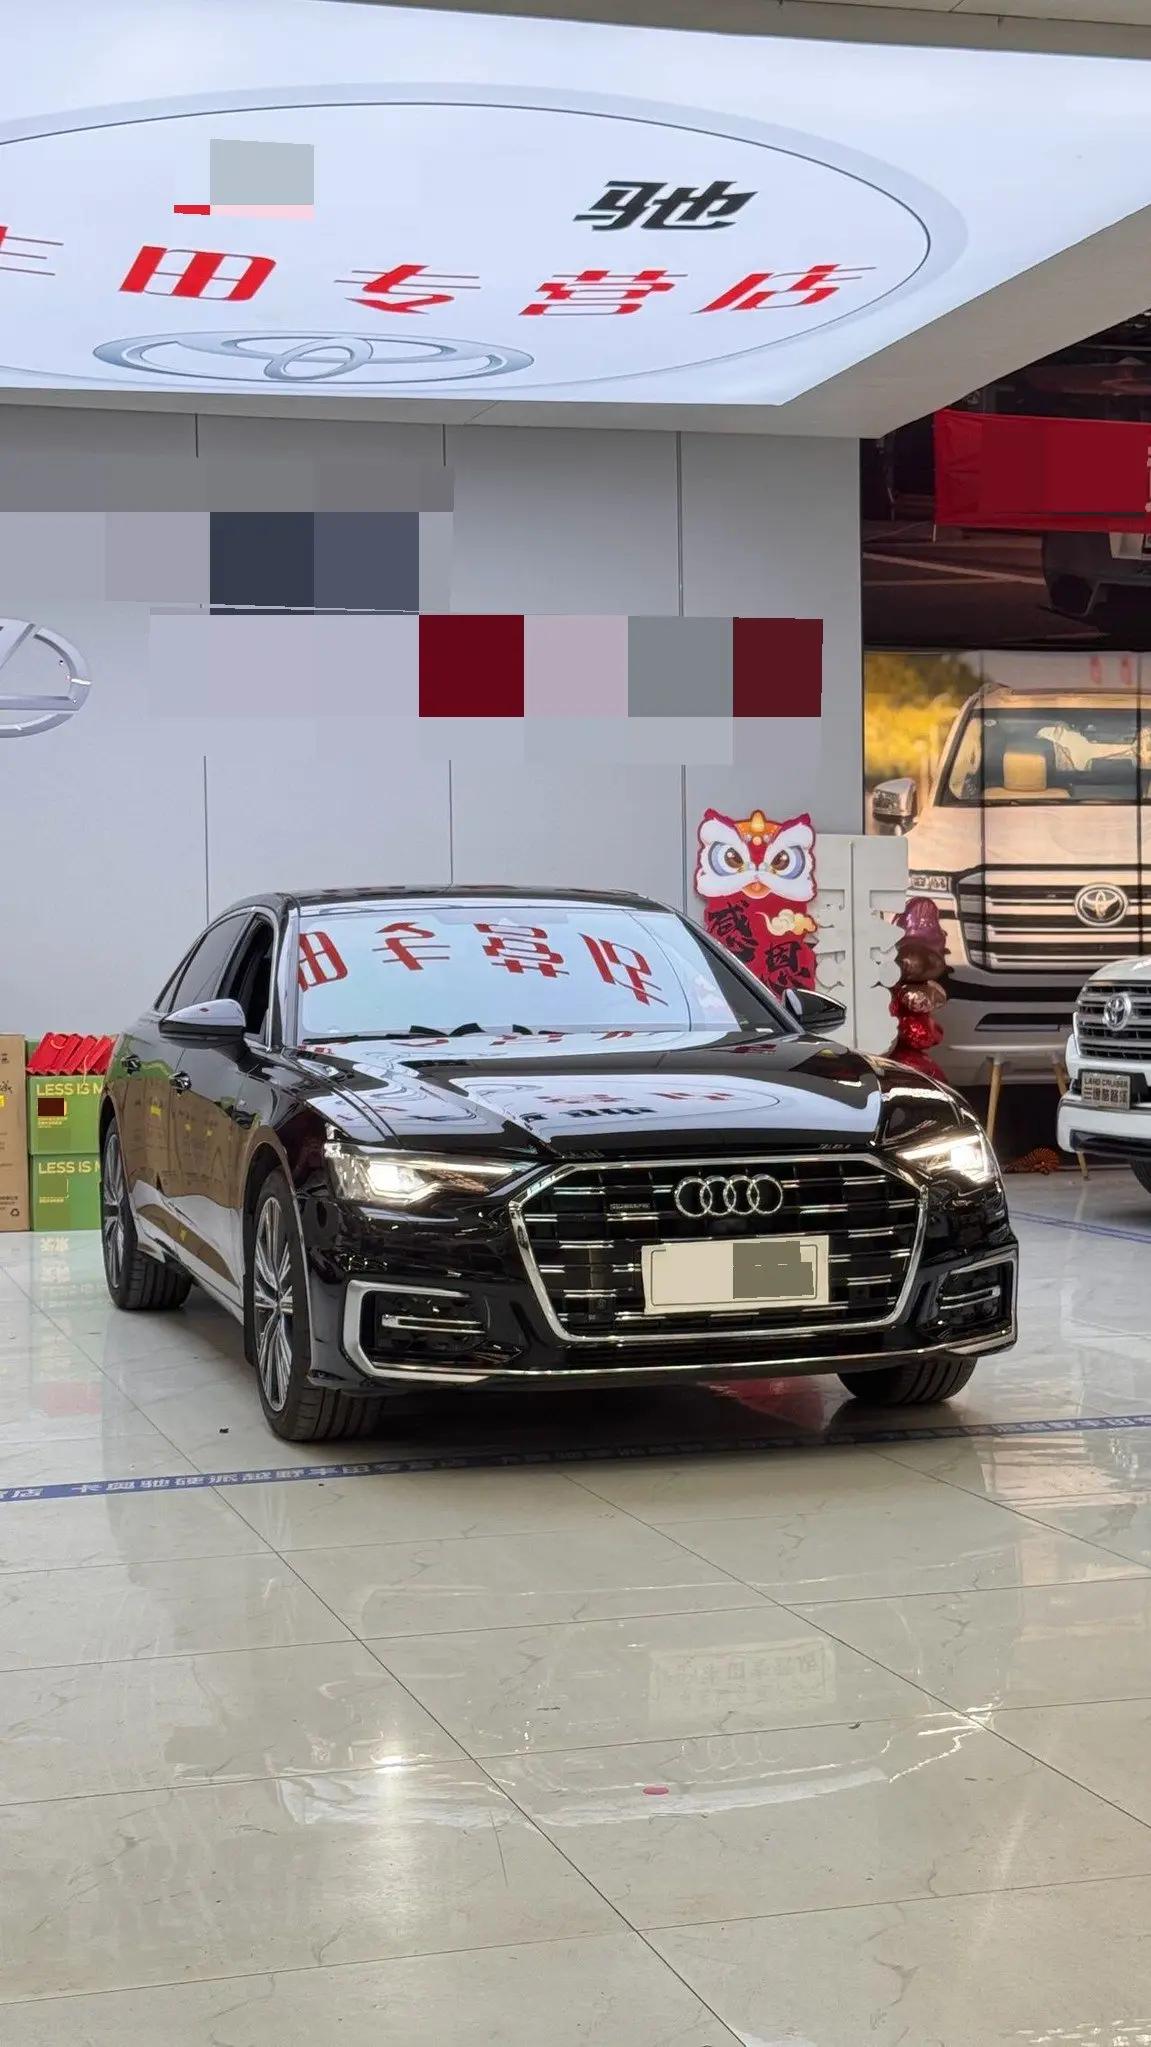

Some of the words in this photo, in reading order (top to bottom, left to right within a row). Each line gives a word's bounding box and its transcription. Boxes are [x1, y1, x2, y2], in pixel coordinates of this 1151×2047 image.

[573, 180, 759, 231] 驰
[36, 1083, 74, 1096] LESS
[77, 1082, 90, 1095] IS
[38, 1161, 75, 1174] LESS
[78, 1160, 91, 1173] IS
